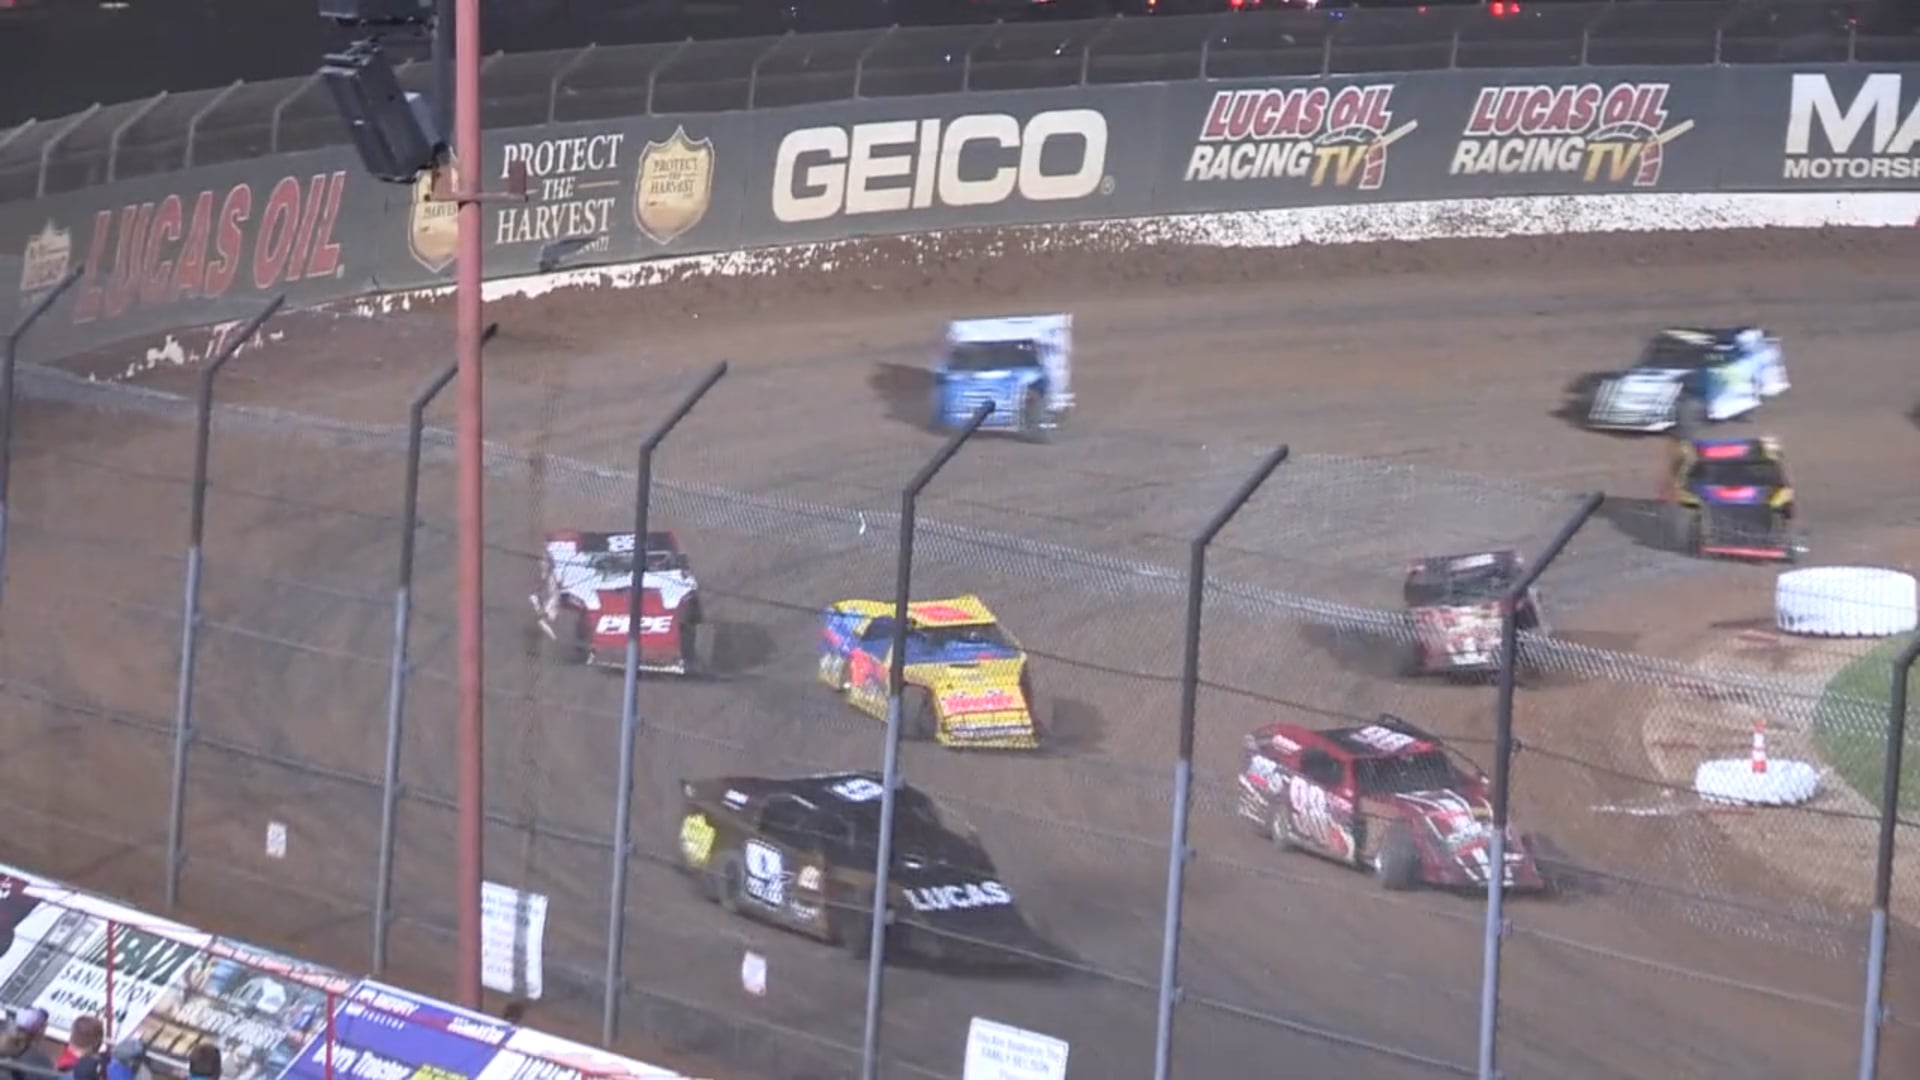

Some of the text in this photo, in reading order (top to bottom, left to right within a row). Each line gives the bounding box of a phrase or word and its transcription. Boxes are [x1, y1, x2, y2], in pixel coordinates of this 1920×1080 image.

[1200, 84, 1395, 141] LUCAS OIL
[1463, 83, 1671, 136] LUCAS OIL
[501, 133, 624, 178] PROTECT
[653, 157, 698, 173] PROTECT
[772, 109, 1108, 222] GEICO
[1184, 141, 1314, 181] RACING
[1449, 137, 1586, 175] RACING
[541, 177, 576, 201] THE
[650, 179, 696, 194] HARVEST
[495, 198, 615, 245] HARVEST
[72, 171, 347, 324] LUCAS OIL
[902, 880, 1013, 912] LUCAS
